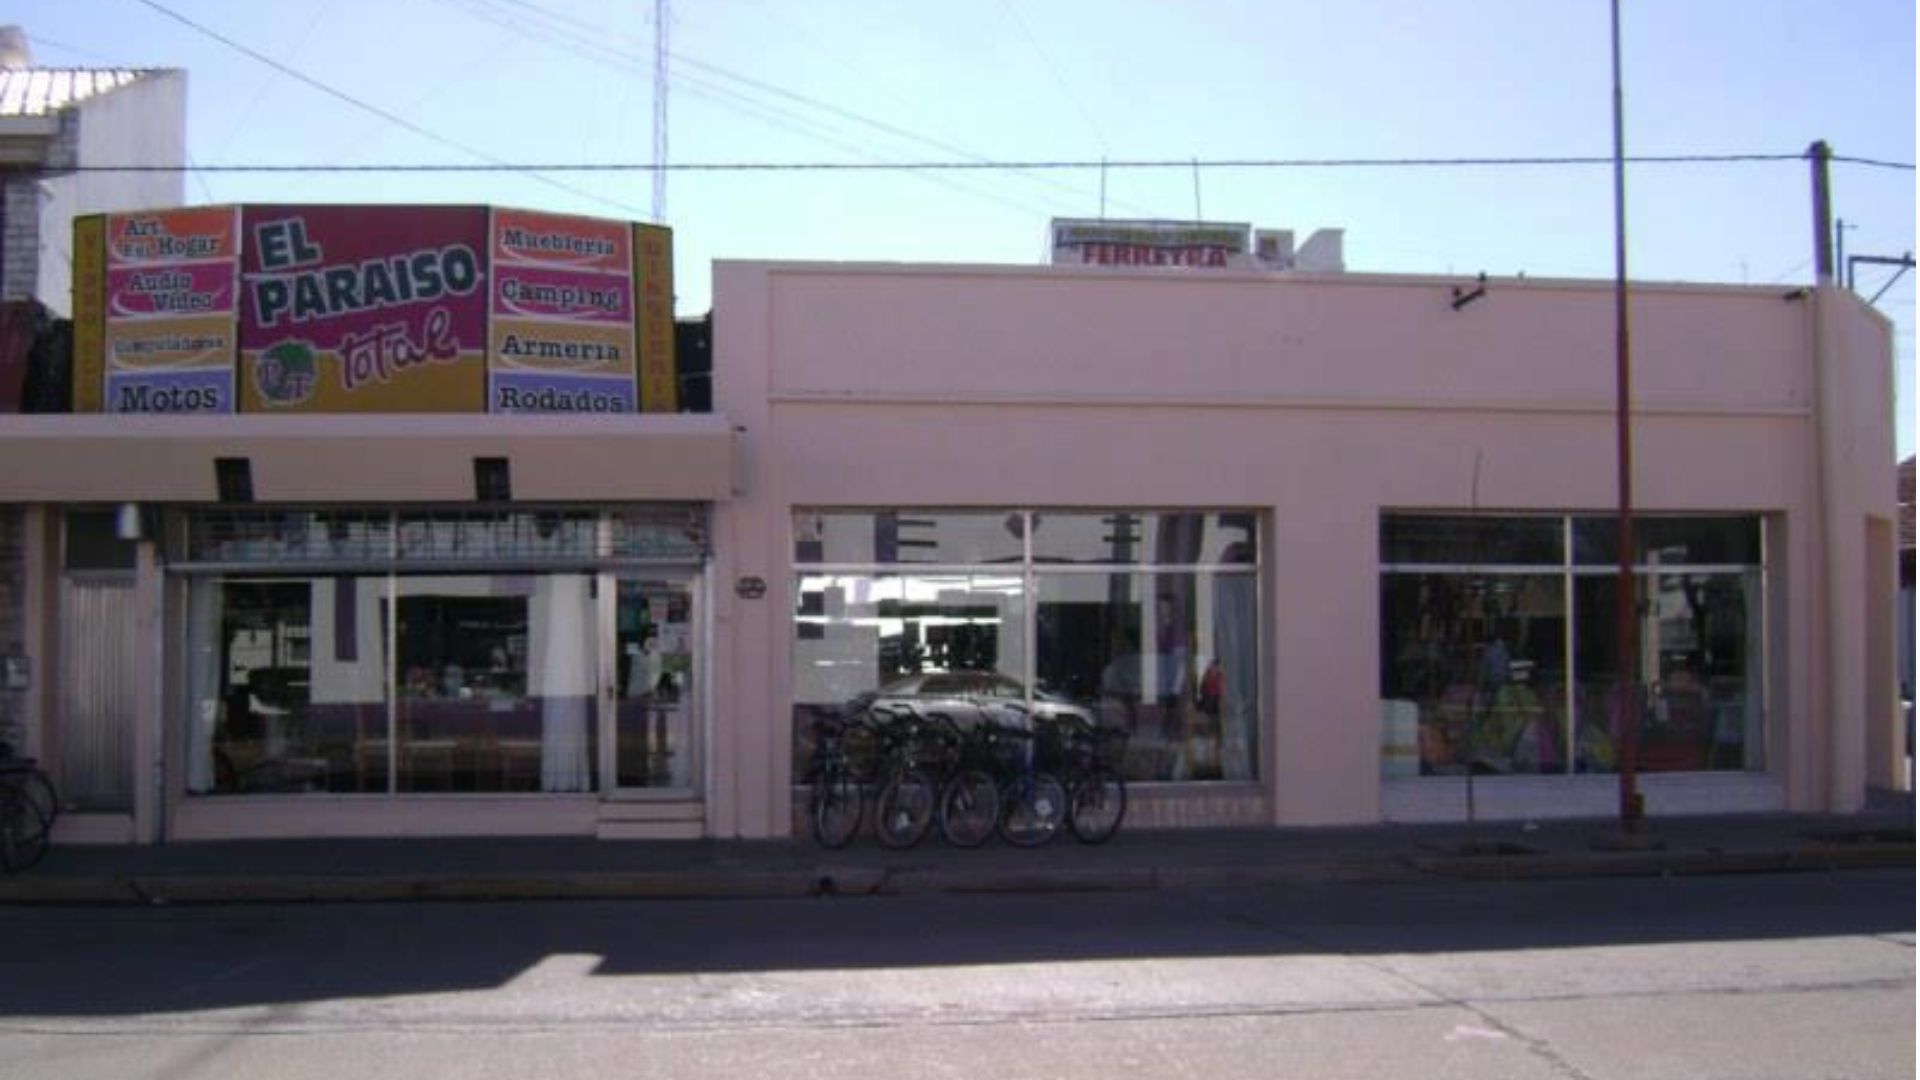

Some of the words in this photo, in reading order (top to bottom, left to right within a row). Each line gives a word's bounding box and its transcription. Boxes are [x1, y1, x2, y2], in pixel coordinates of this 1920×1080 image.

[157, 236, 221, 257] Hogar
[256, 219, 321, 270] EL
[129, 270, 193, 292] Audio
[256, 246, 476, 327] PARAISO
[502, 279, 621, 313] Camping
[338, 307, 458, 389] total
[118, 384, 219, 412] Motos
[499, 386, 624, 413] Rodados
